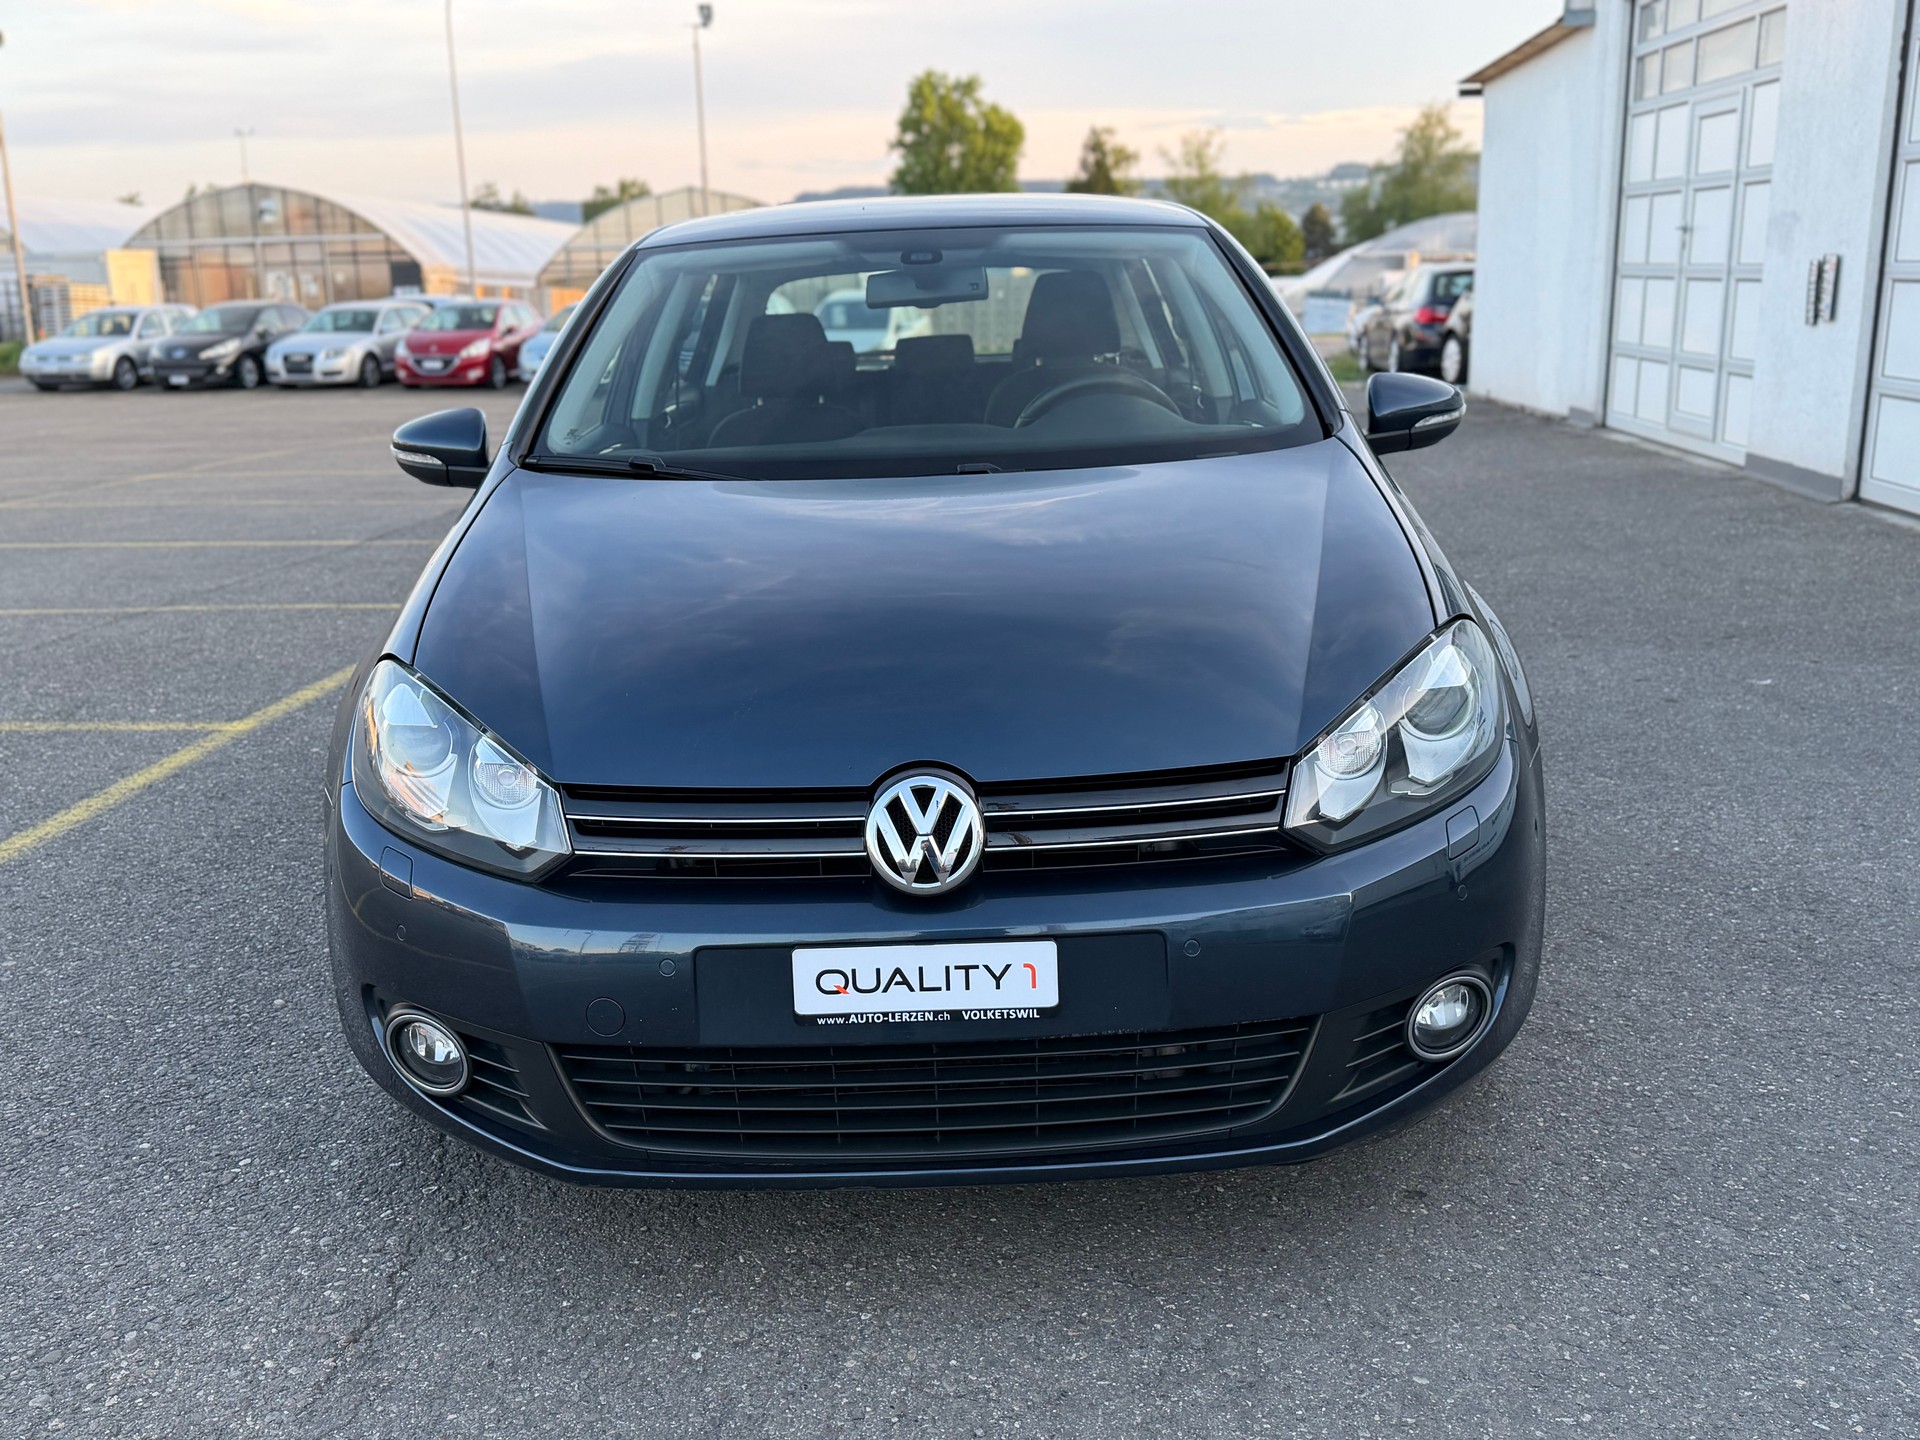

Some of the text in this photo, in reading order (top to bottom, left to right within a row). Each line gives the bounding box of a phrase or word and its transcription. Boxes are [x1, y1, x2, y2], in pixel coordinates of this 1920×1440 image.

[815, 963, 1013, 995] QUALITY
[816, 1008, 1041, 1025] www.AUTO-LERZEN.ch VOLKETSWIL
